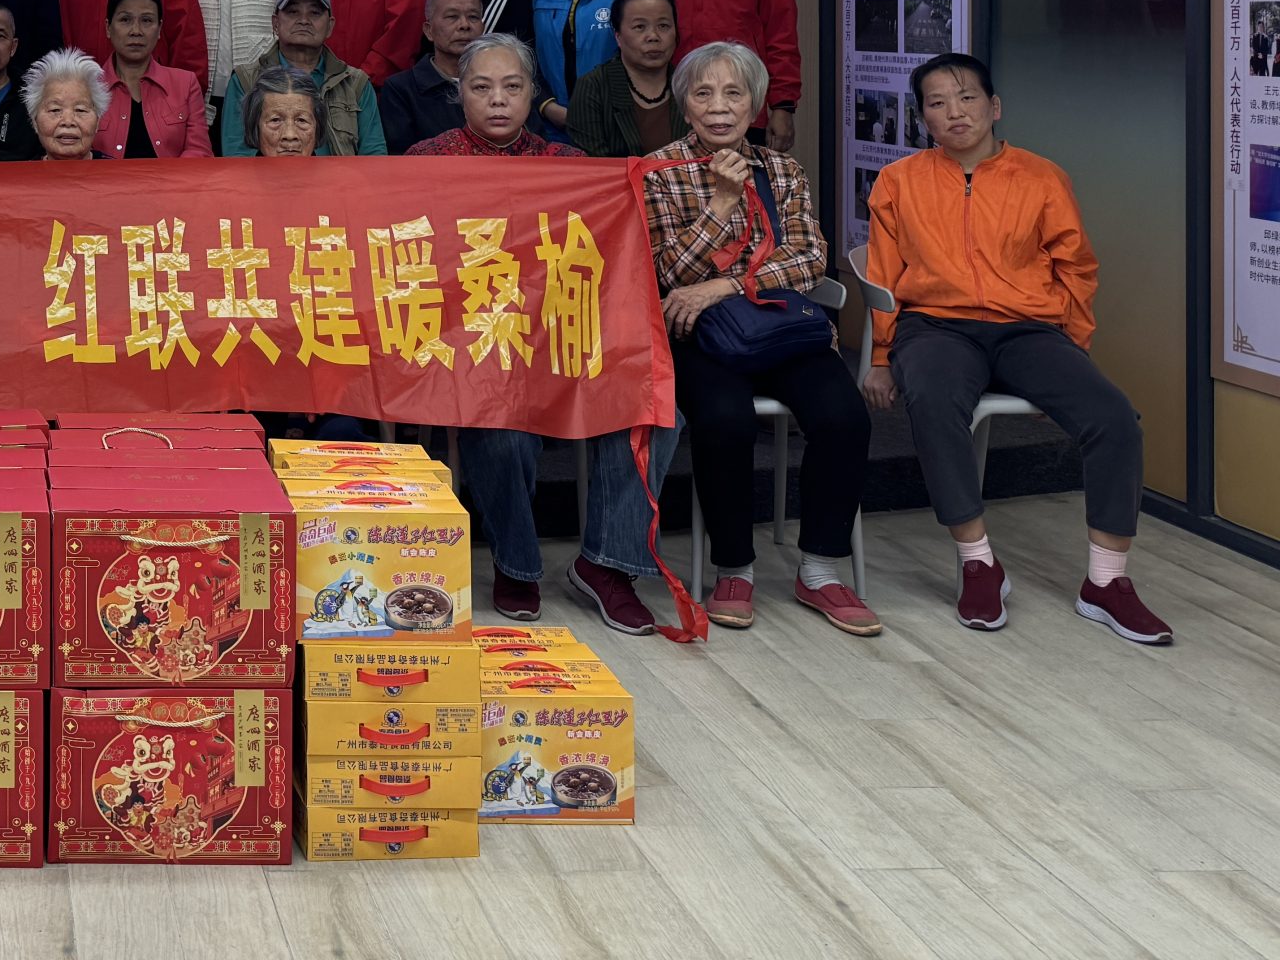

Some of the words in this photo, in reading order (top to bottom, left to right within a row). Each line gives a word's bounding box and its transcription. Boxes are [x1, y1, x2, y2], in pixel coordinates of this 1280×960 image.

[1264, 85, 1280, 97] 王元
[1249, 114, 1280, 126] 方探讨解
[1264, 229, 1280, 240] 邱绿
[1249, 256, 1280, 271] 新创业生
[42, 211, 606, 381] 红联共建暖桑榆
[368, 525, 465, 546] 陈皮莲子红豆沙
[392, 572, 446, 587] 香浓绵滑
[334, 653, 451, 665] 广州市泰奇食品有限公司
[535, 708, 628, 728] 陈皮莲子红豆沙
[336, 759, 453, 772] 广州市泰奇食品有限公司
[559, 753, 610, 767] 香浓绵滑
[336, 811, 450, 823] 广州市泰奇食品有限公司
